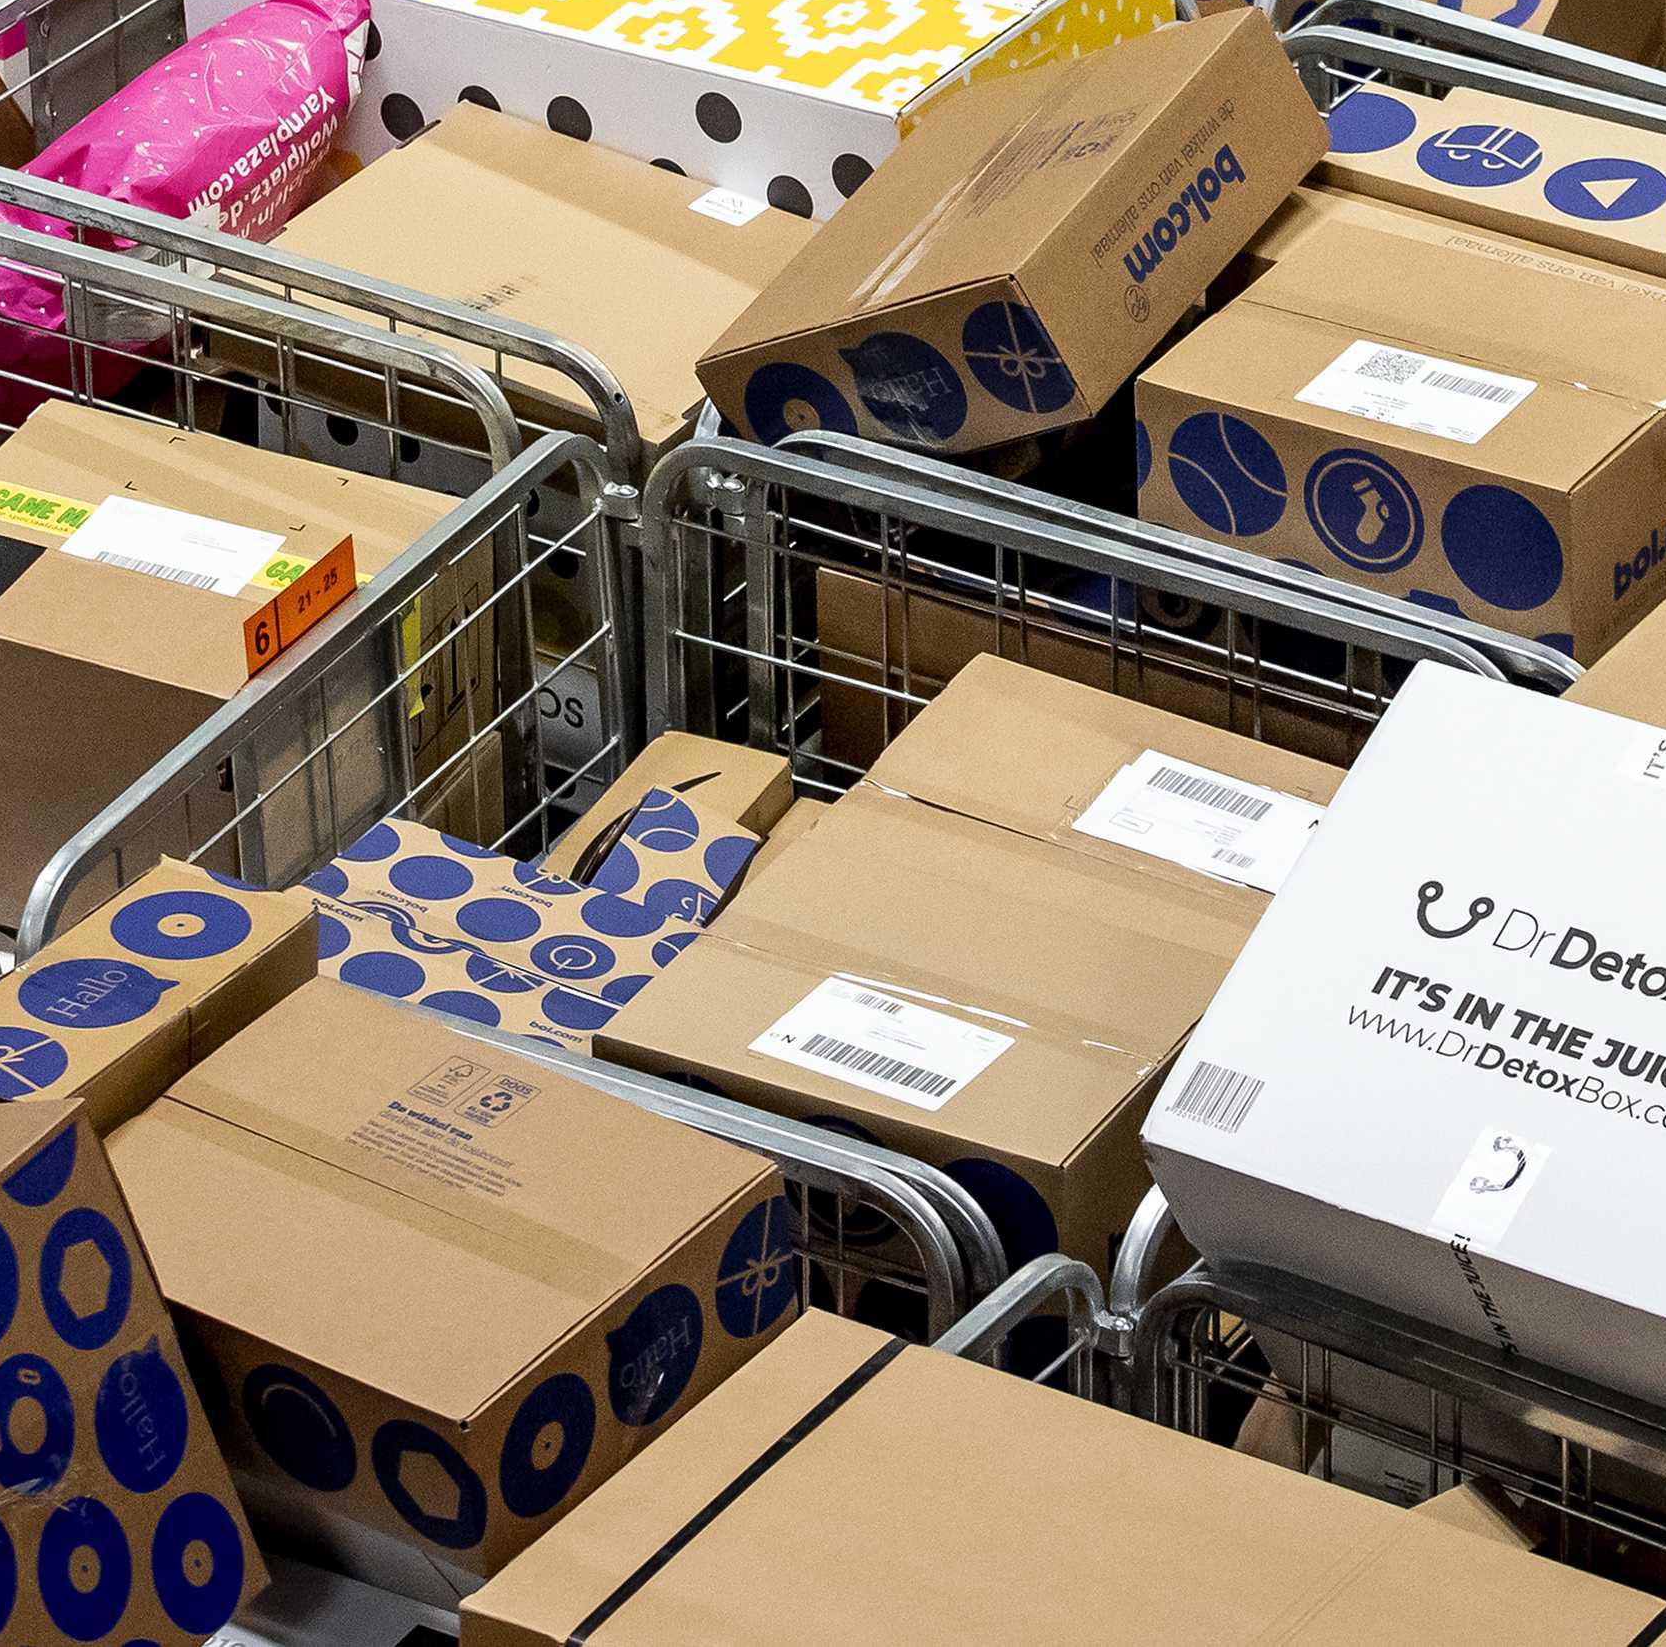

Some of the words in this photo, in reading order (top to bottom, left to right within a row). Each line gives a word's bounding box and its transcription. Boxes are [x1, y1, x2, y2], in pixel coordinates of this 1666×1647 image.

[1123, 144, 1246, 284] bol.com
[1138, 181, 1161, 211] ons
[297, 590, 312, 613] 21
[322, 569, 339, 590] 25
[255, 633, 270, 656] 6
[46, 969, 130, 1019] Hallo
[1371, 966, 1453, 1013] IT'S
[1453, 991, 1505, 1031] IN
[1512, 1007, 1595, 1059] THE
[529, 1020, 583, 1044] bol.com
[620, 1315, 693, 1390] Hallo
[119, 1356, 167, 1474] Hallo
